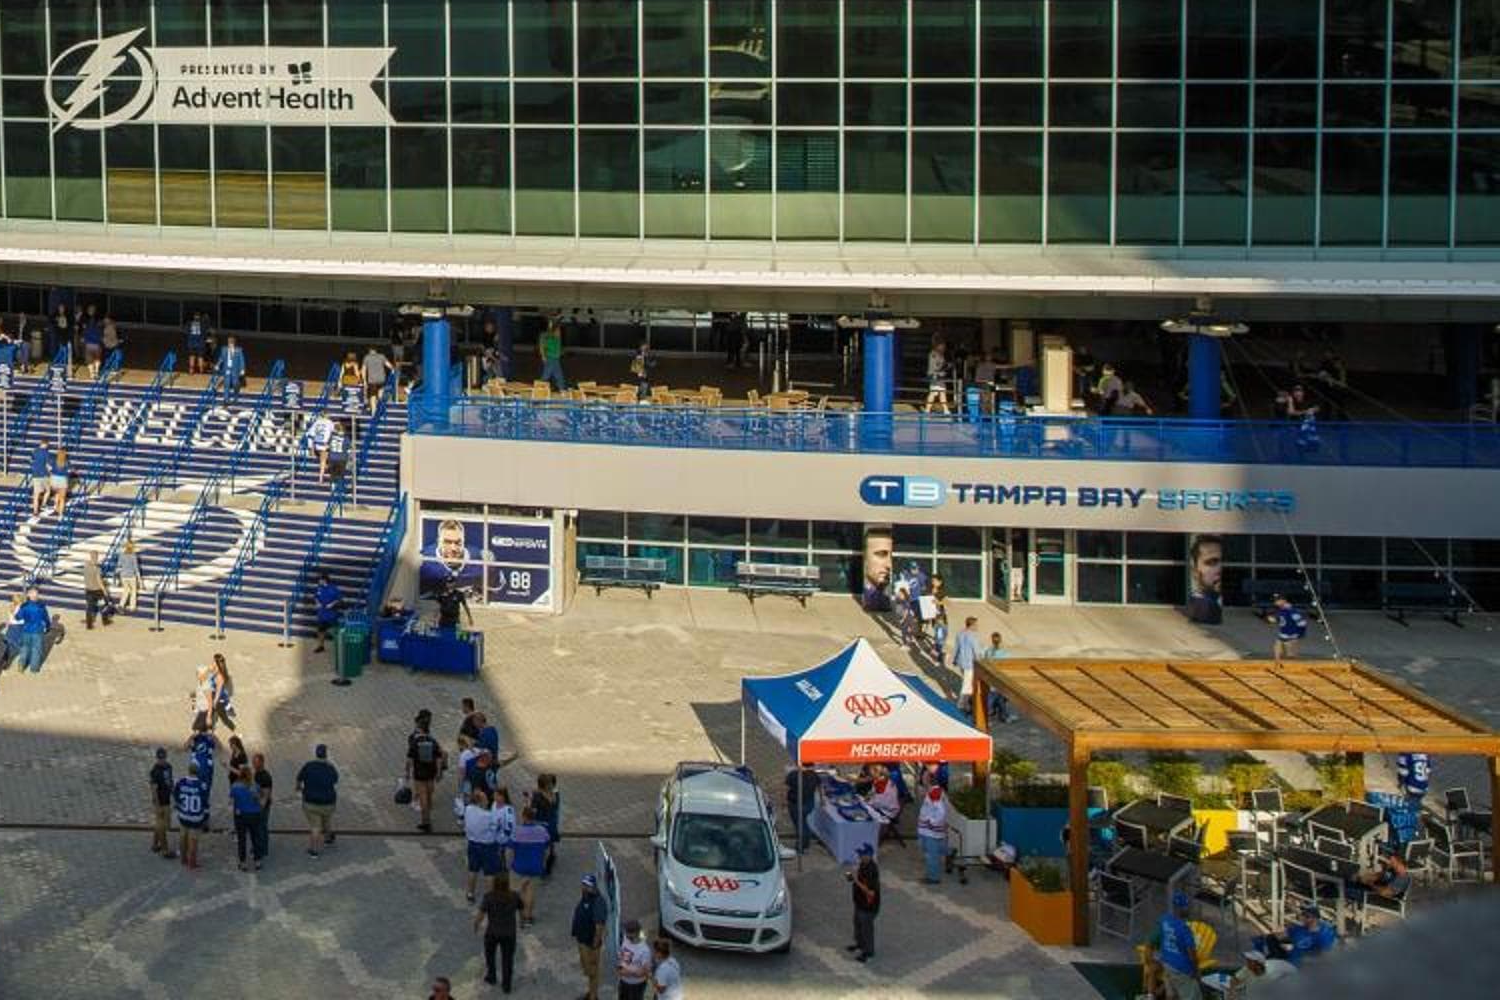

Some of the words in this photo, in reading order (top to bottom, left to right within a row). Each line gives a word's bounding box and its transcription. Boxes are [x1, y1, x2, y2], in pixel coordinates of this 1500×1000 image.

[180, 63, 254, 76] PRESENTED
[260, 63, 276, 75] BY
[869, 480, 942, 502] TB
[952, 483, 1067, 507] TAMPA
[1078, 487, 1146, 509] BAY
[1156, 488, 1297, 514] SPORTS
[510, 571, 531, 590] 88
[847, 696, 890, 716] AAA
[850, 743, 942, 758] MEMBERSHIP
[179, 793, 201, 813] 30
[692, 875, 740, 892] AAA
